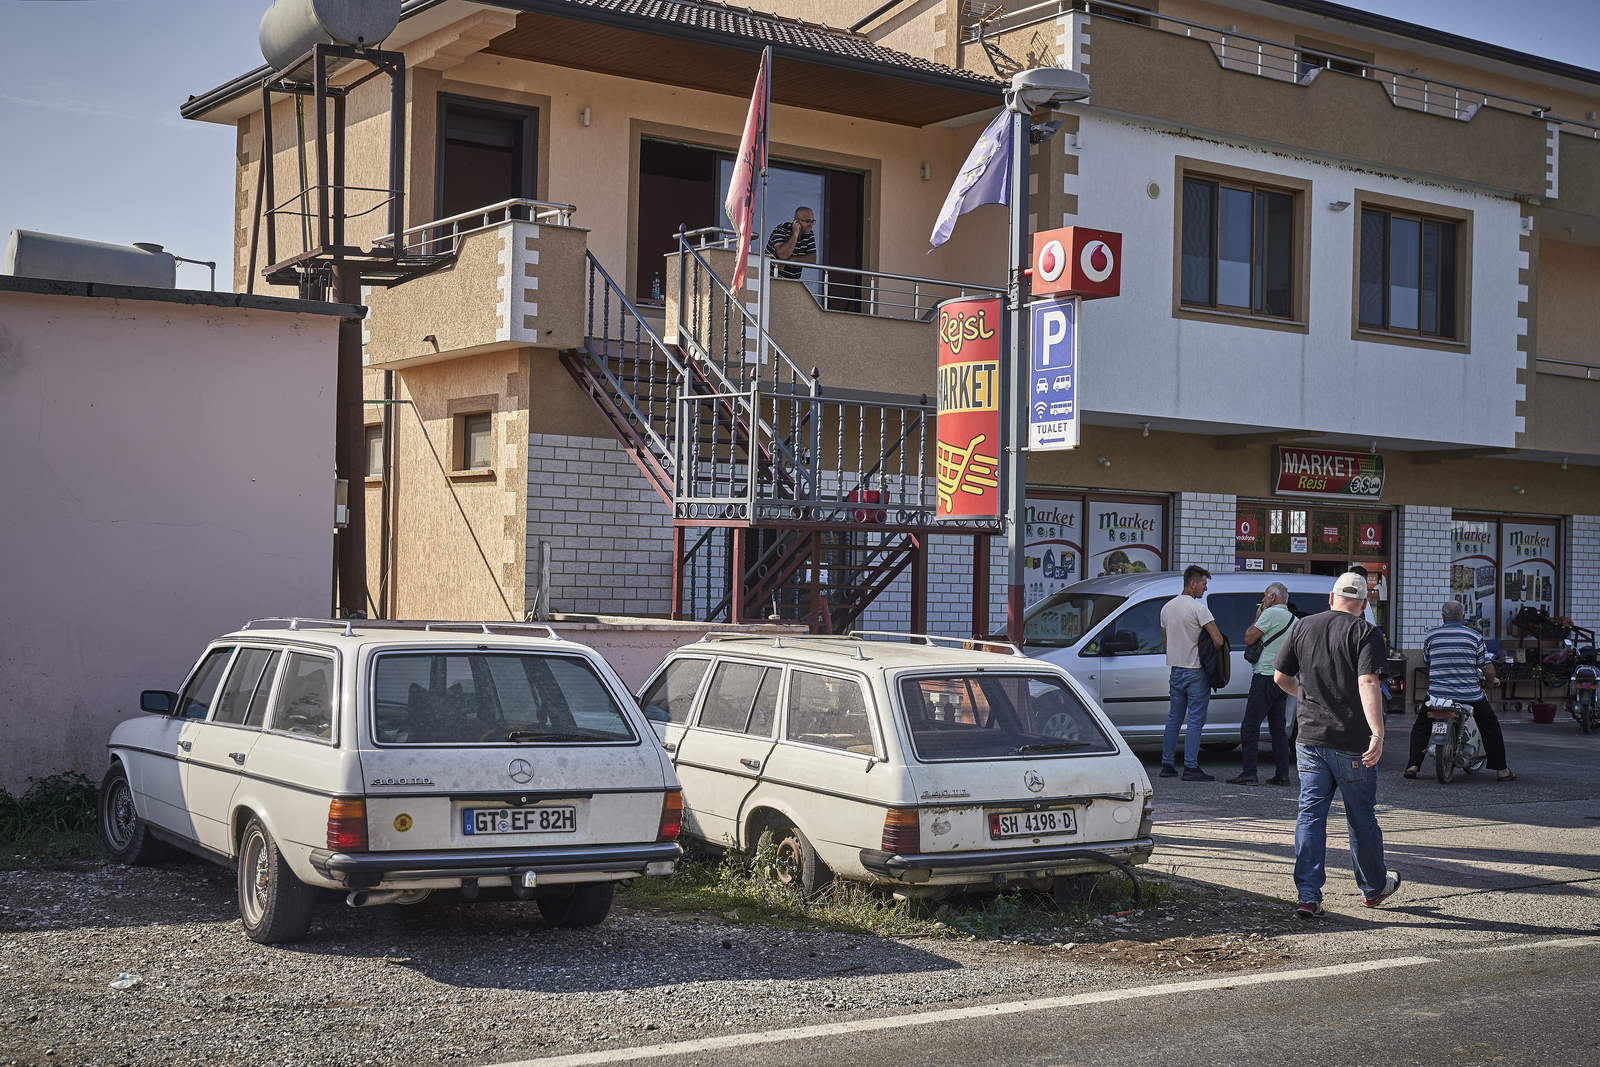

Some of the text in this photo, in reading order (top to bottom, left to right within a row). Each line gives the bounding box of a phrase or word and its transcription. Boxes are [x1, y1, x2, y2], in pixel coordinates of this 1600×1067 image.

[940, 309, 995, 355] Rejsi
[1042, 311, 1067, 366] P
[1037, 422, 1068, 434] TUALET
[1285, 452, 1355, 477] MARKET
[1298, 476, 1328, 490] Rejsi
[475, 809, 574, 832] GT EF 82H
[1001, 812, 1071, 834] SH 4198 D
